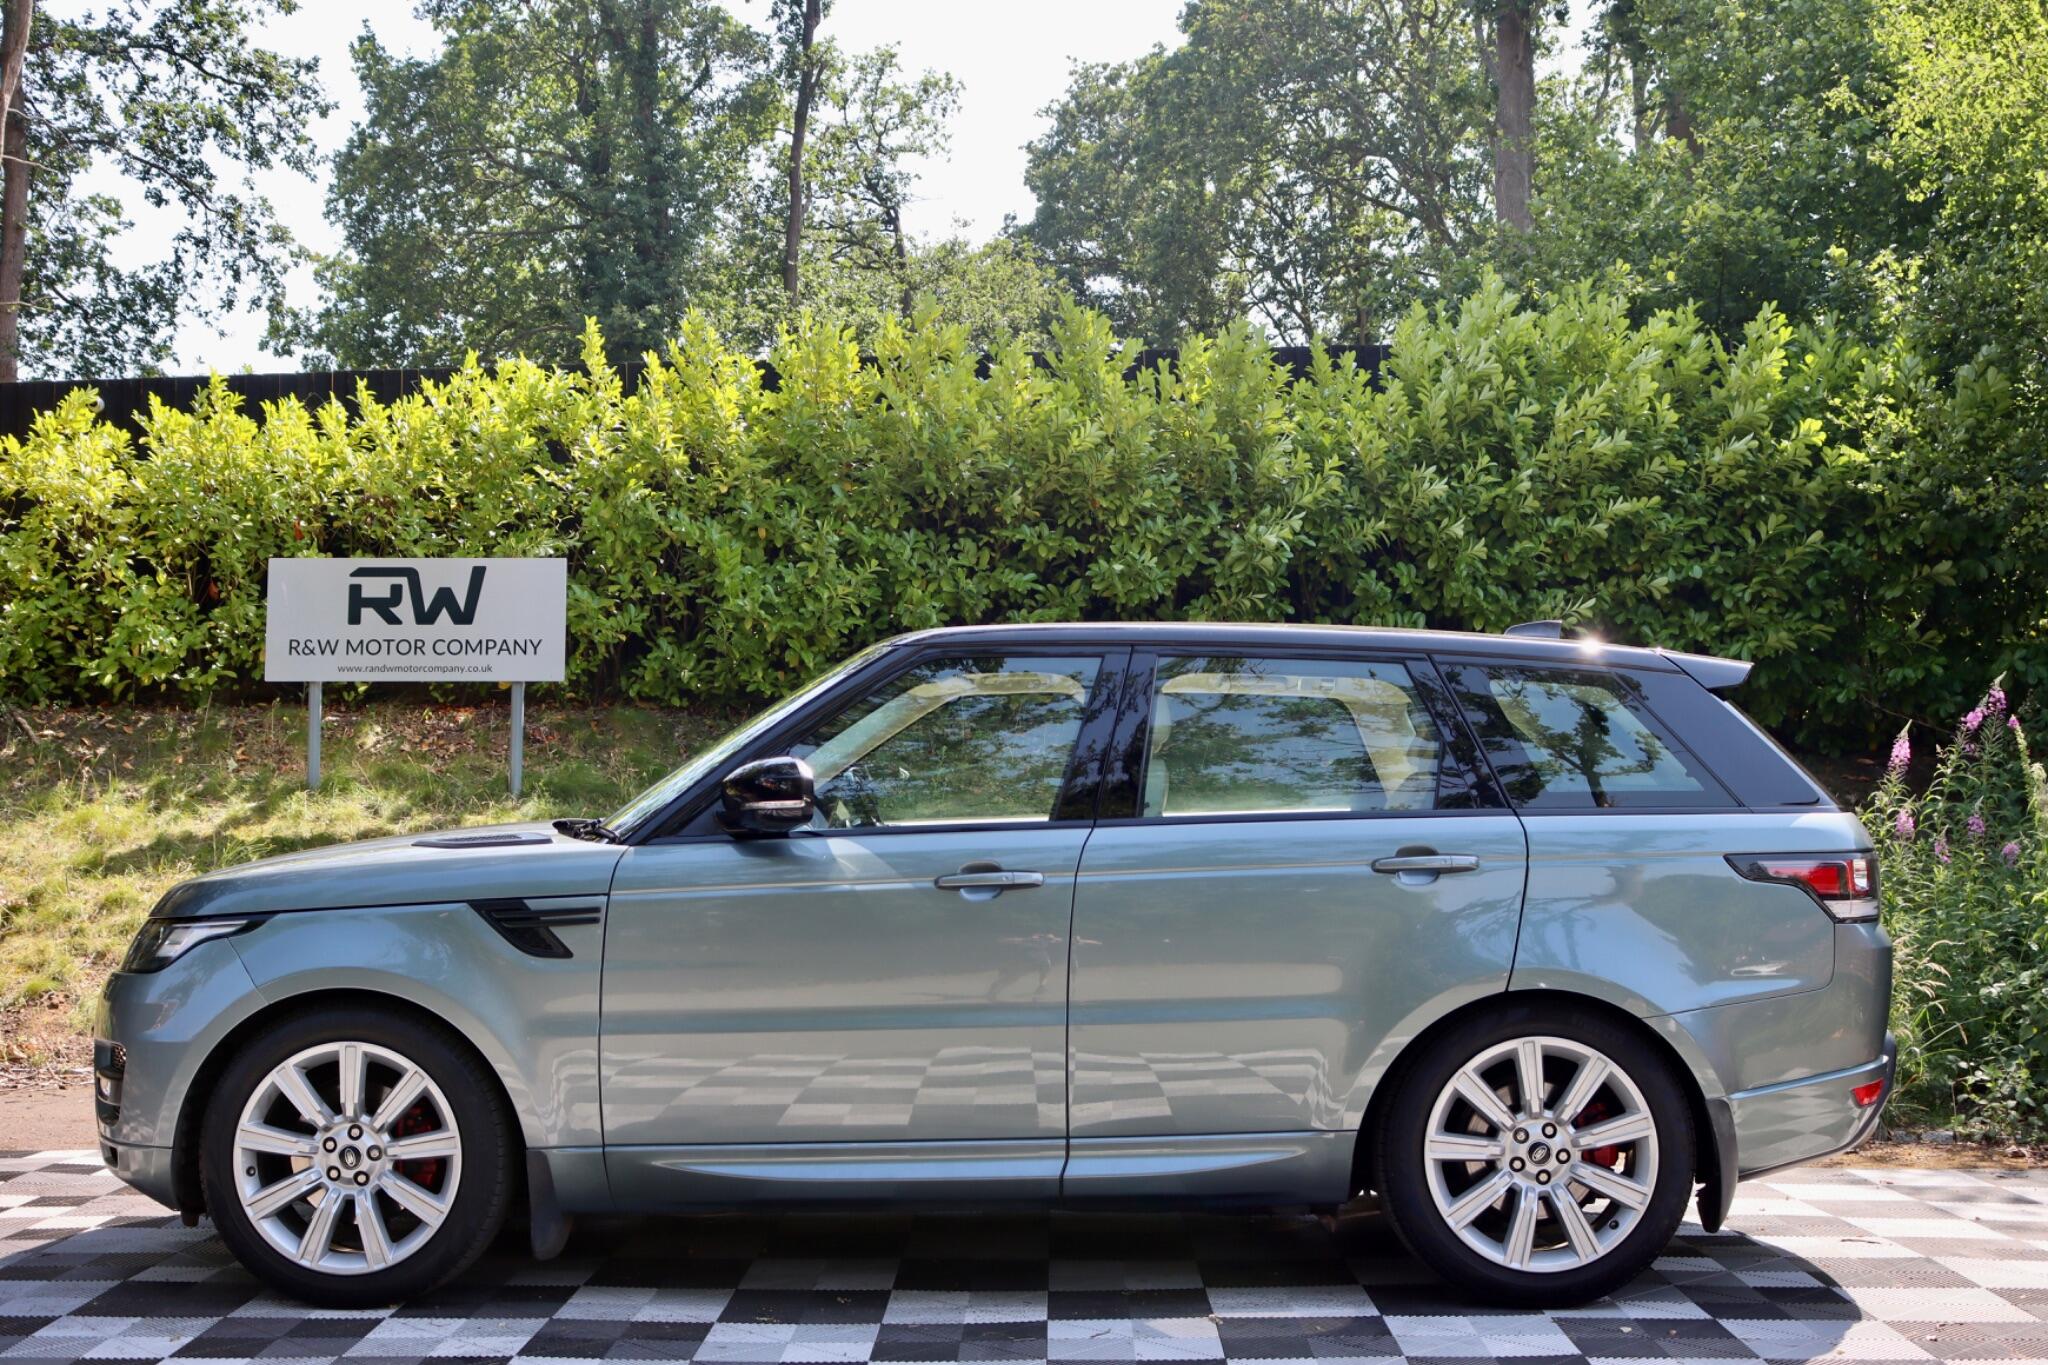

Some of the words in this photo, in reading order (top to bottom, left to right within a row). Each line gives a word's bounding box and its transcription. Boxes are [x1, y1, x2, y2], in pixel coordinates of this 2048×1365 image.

[347, 565, 488, 626] RW
[288, 638, 340, 656] R&W
[345, 638, 426, 656] MOTOR
[432, 638, 543, 656] COMPANY
[337, 663, 493, 675] www.randwmotorcompany.co.uk
